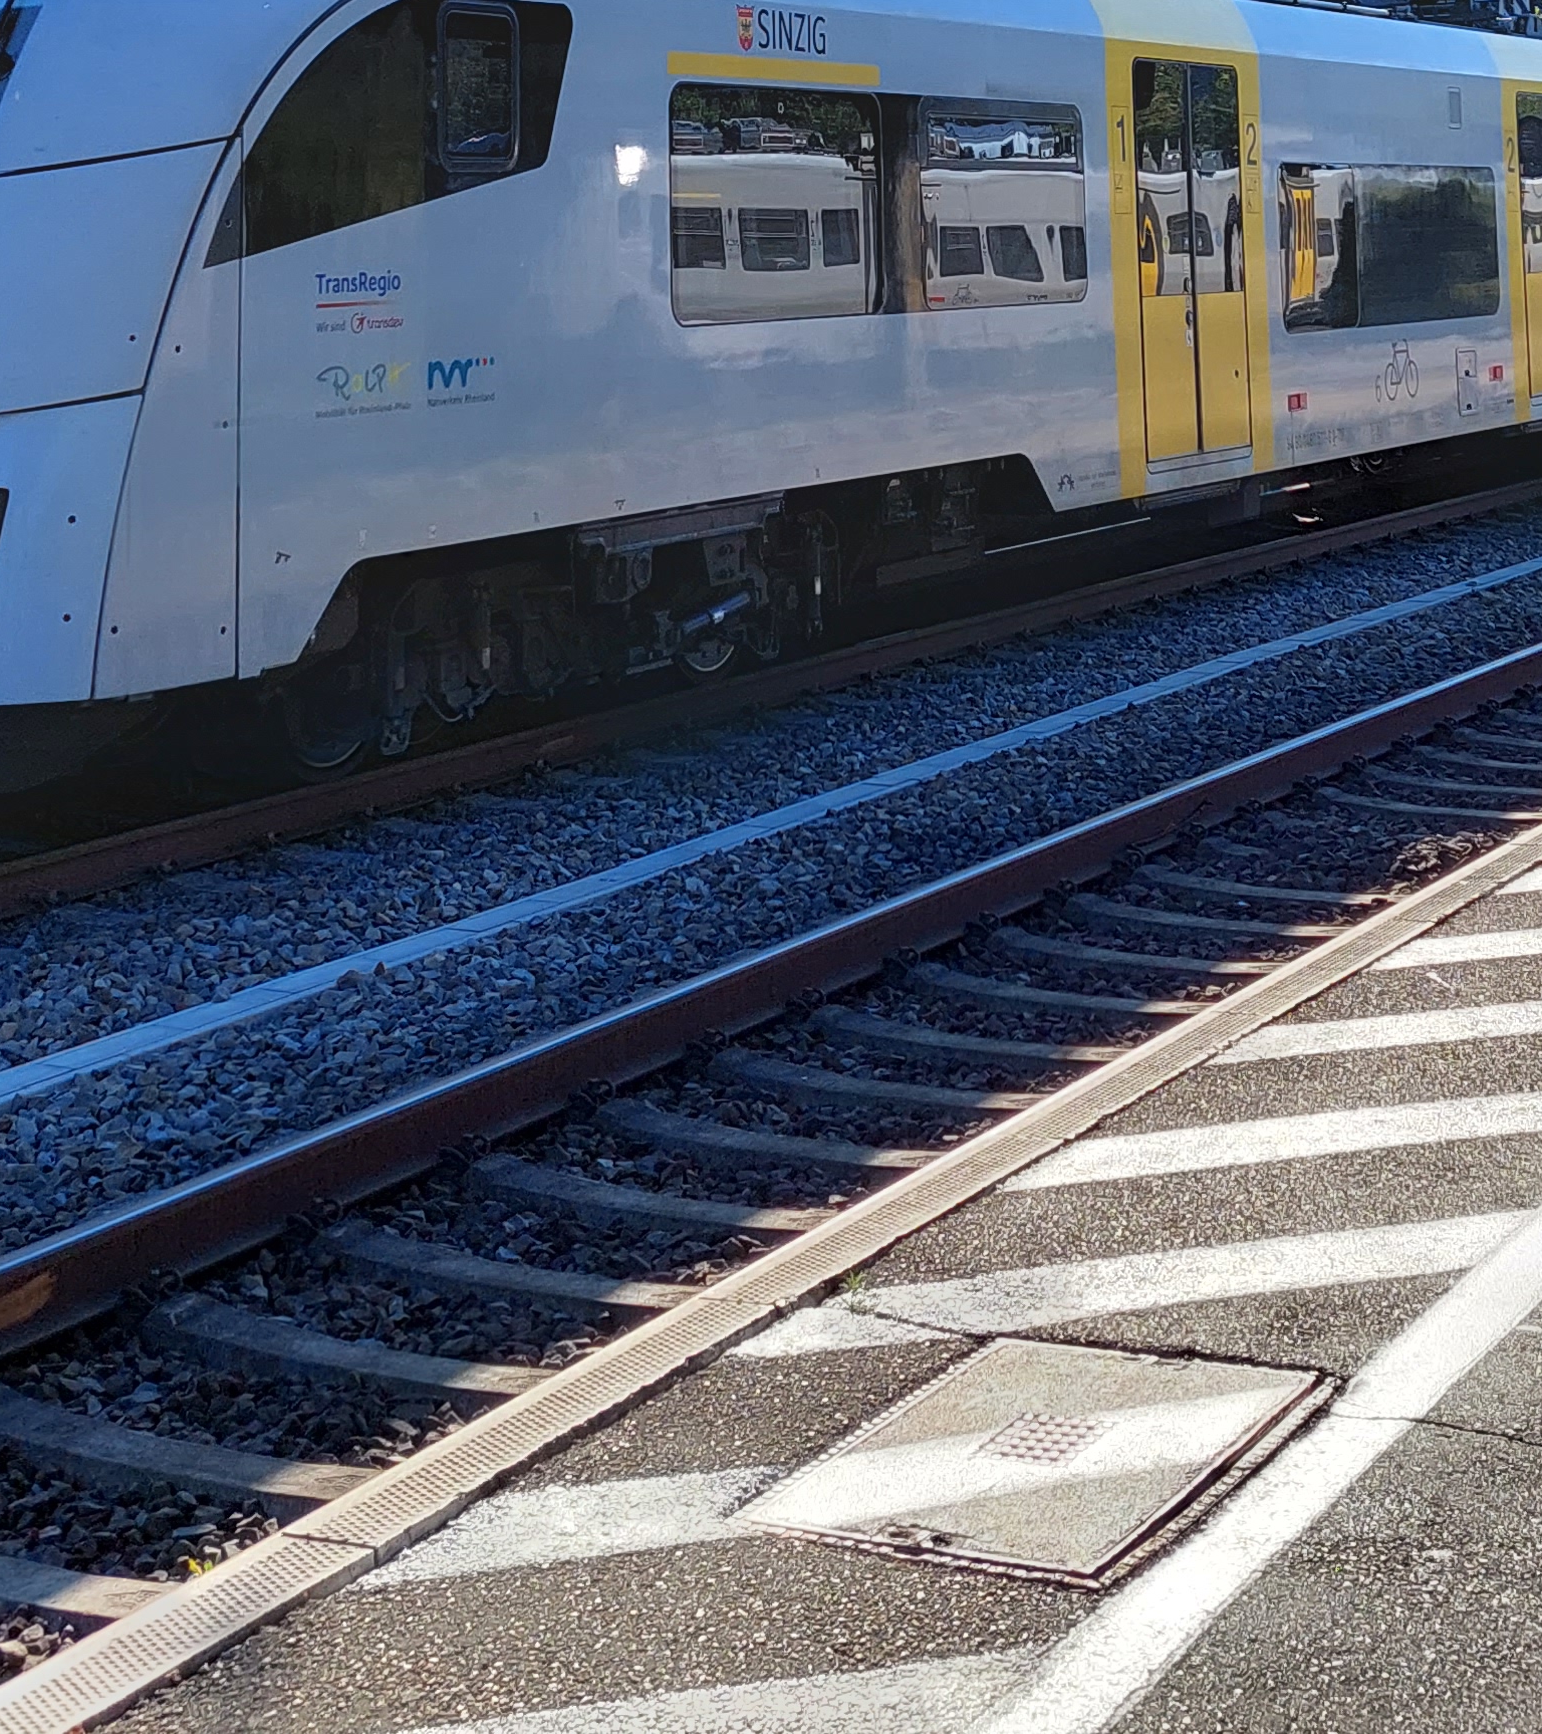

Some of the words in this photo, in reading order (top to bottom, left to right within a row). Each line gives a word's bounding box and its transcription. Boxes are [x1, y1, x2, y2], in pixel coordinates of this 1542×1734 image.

[757, 8, 826, 55] SINZIG
[1115, 114, 1126, 162] 1
[1245, 121, 1258, 166] 2
[1506, 136, 1516, 173] 2
[314, 269, 402, 298] TransRegio
[1374, 374, 1382, 403] 6
